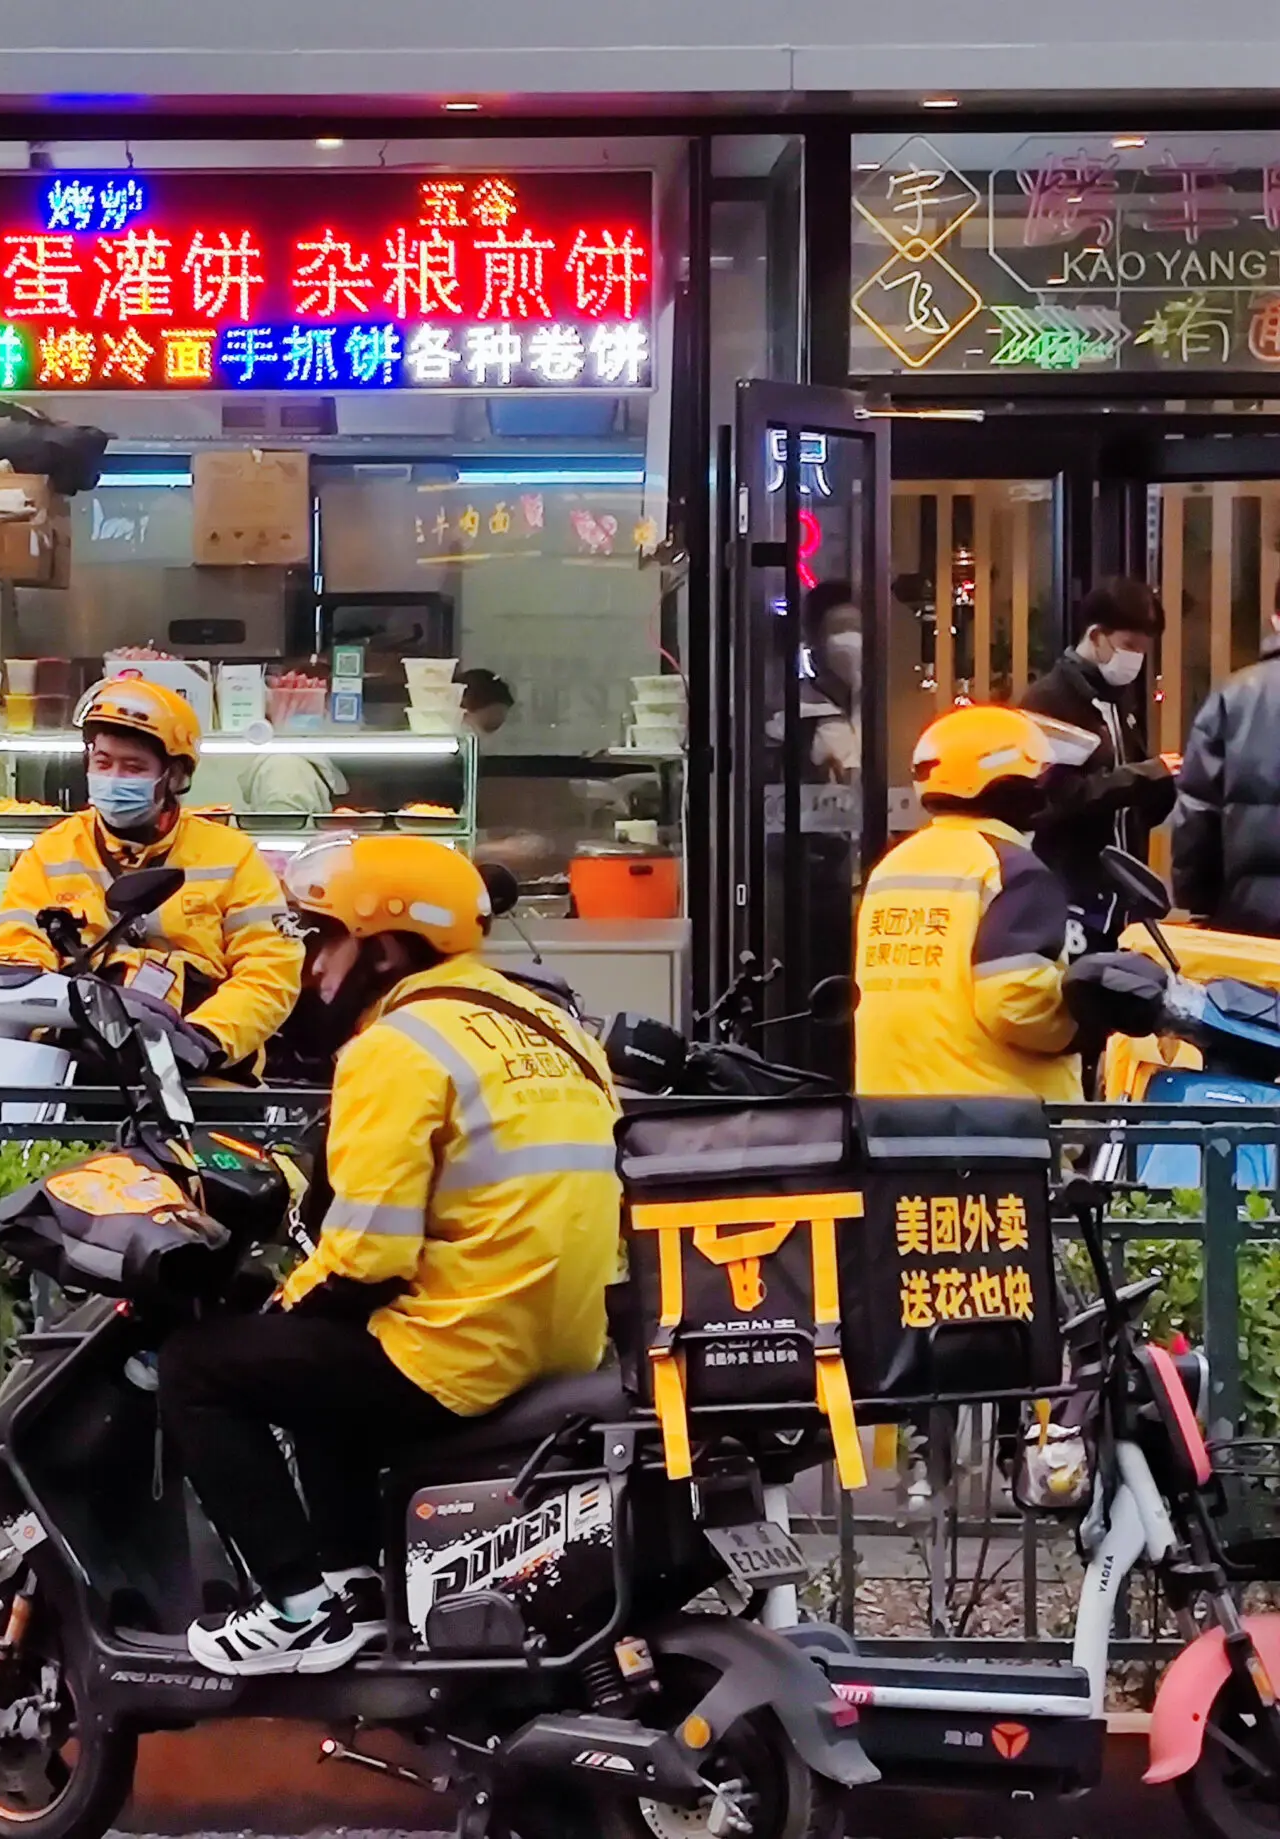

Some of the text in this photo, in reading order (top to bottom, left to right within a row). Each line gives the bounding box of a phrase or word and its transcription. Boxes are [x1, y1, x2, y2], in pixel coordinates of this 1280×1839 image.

[419, 178, 518, 228] 五谷
[1017, 148, 1280, 246] 烤羊
[293, 229, 650, 321] 杂粮煎饼
[38, 326, 218, 384] 烤冷面
[221, 326, 402, 384] 手抓饼
[406, 325, 650, 385] 各种卷饼
[895, 1194, 1031, 1256] 美团外卖
[900, 1265, 1035, 1328] 送花也快
[431, 1502, 562, 1603] POWER
[1098, 1553, 1115, 1593] YADEA
